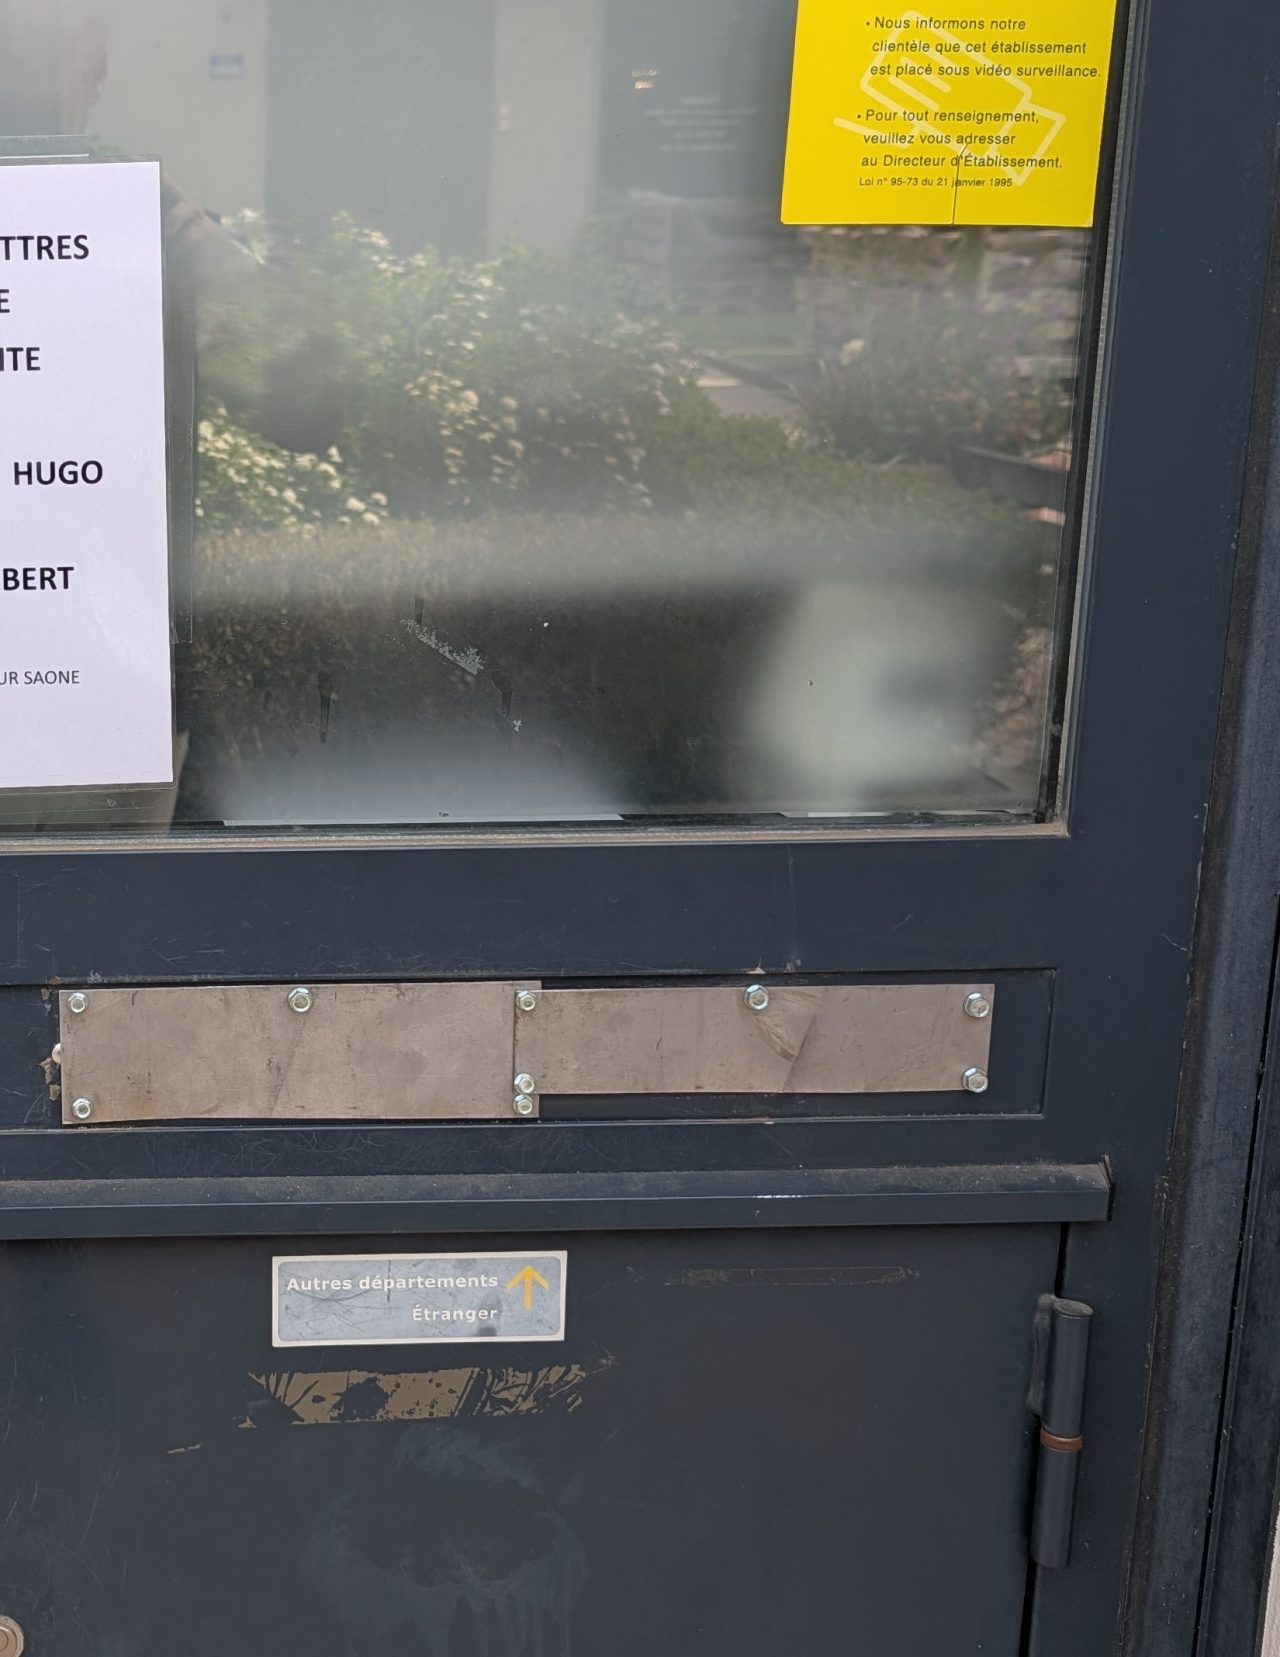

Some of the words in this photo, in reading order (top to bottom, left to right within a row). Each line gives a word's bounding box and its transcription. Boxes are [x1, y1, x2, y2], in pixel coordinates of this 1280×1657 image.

[875, 17, 910, 30] Nous
[916, 17, 985, 30] informons
[990, 18, 1026, 30] notre
[872, 41, 930, 52] clientèle
[935, 42, 960, 55] que
[966, 42, 987, 53] cet
[991, 41, 1087, 54] établissement
[871, 64, 891, 76] est
[896, 63, 932, 78] placé
[938, 65, 970, 76] sous
[975, 64, 1012, 77] vidéo
[1016, 64, 1101, 78] surveillance.
[866, 109, 898, 122] Pour
[902, 110, 929, 122] tout
[934, 110, 1039, 125] renseignement,
[863, 133, 915, 145] veuillez
[920, 134, 951, 145] vous
[956, 133, 1016, 145] adresser
[861, 156, 878, 166] au
[883, 154, 946, 167] Directeur
[951, 153, 1062, 168] d'Établissement.
[859, 178, 874, 186] Loi
[877, 177, 888, 187] n°
[891, 178, 919, 187] 95-73
[922, 178, 934, 187] du
[937, 178, 948, 187] 21
[951, 178, 985, 188] janvier
[989, 178, 1012, 187] 1995
[13, 459, 103, 486] HUGO
[2, 566, 75, 592] BERT
[24, 669, 80, 686] SAONE
[287, 1277, 353, 1291] Autres
[359, 1275, 498, 1291] départements
[412, 1304, 498, 1321] Étranger
